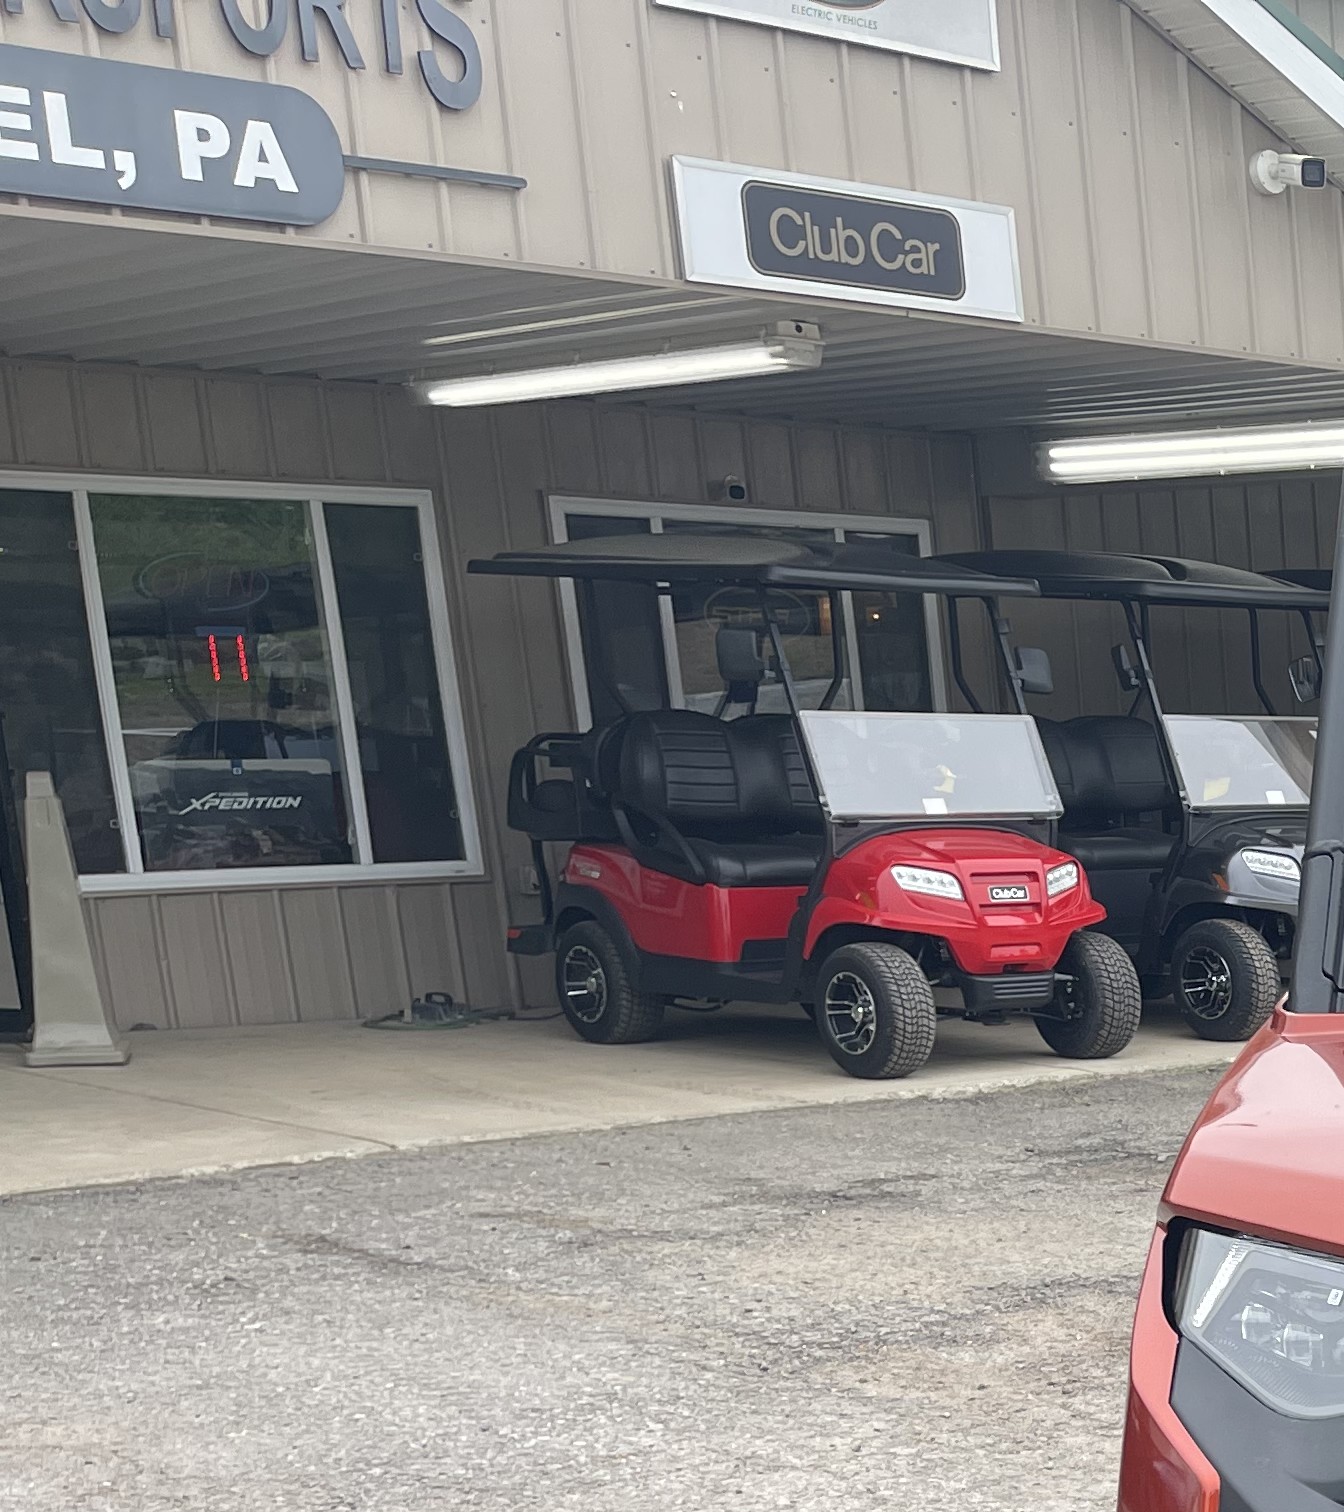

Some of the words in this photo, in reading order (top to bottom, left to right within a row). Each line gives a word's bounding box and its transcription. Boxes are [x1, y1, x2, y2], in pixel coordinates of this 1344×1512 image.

[791, 4, 834, 21] ELECTRIC
[836, 13, 879, 30] VEHICLES
[173, 109, 300, 193] PA
[769, 207, 866, 266] Club
[870, 222, 941, 276] Car
[178, 792, 302, 816] XPEDITION
